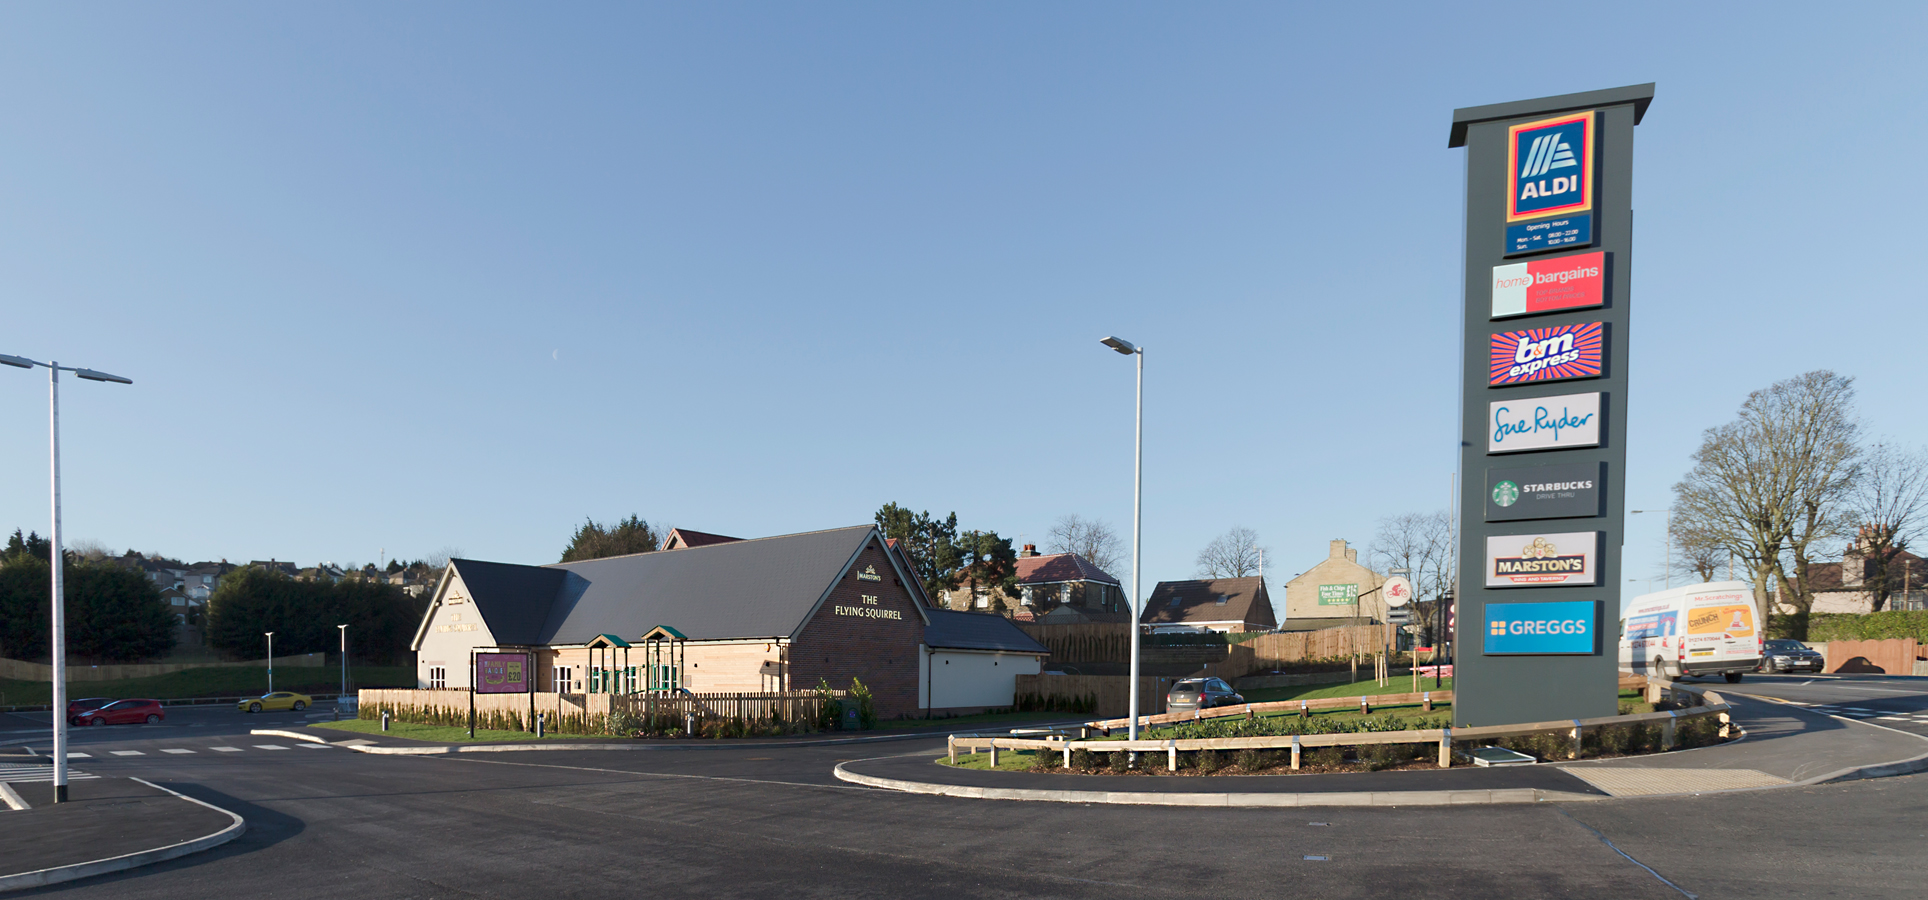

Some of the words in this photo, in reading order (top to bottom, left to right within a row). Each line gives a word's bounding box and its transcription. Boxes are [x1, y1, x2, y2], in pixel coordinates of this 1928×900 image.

[1521, 175, 1577, 200] ALDI
[1526, 223, 1550, 231] Opening
[1495, 276, 1530, 289] home
[1535, 266, 1599, 284] bargains
[1535, 295, 1562, 303] BOTTOM
[1562, 291, 1585, 299] PRICES
[1549, 286, 1575, 294] BRANDS
[1509, 349, 1579, 377] express
[1494, 407, 1532, 442] Sue
[1534, 406, 1594, 441] Ryder
[1523, 480, 1593, 493] STARBUCKS
[1498, 558, 1582, 573] MARSTON'S
[862, 594, 877, 605] THE
[835, 605, 864, 617] FLYING
[865, 607, 902, 620] SQUIRREL
[1509, 619, 1586, 635] GREGGS
[1688, 613, 1719, 628] CRUNCH
[508, 671, 521, 682] £20
